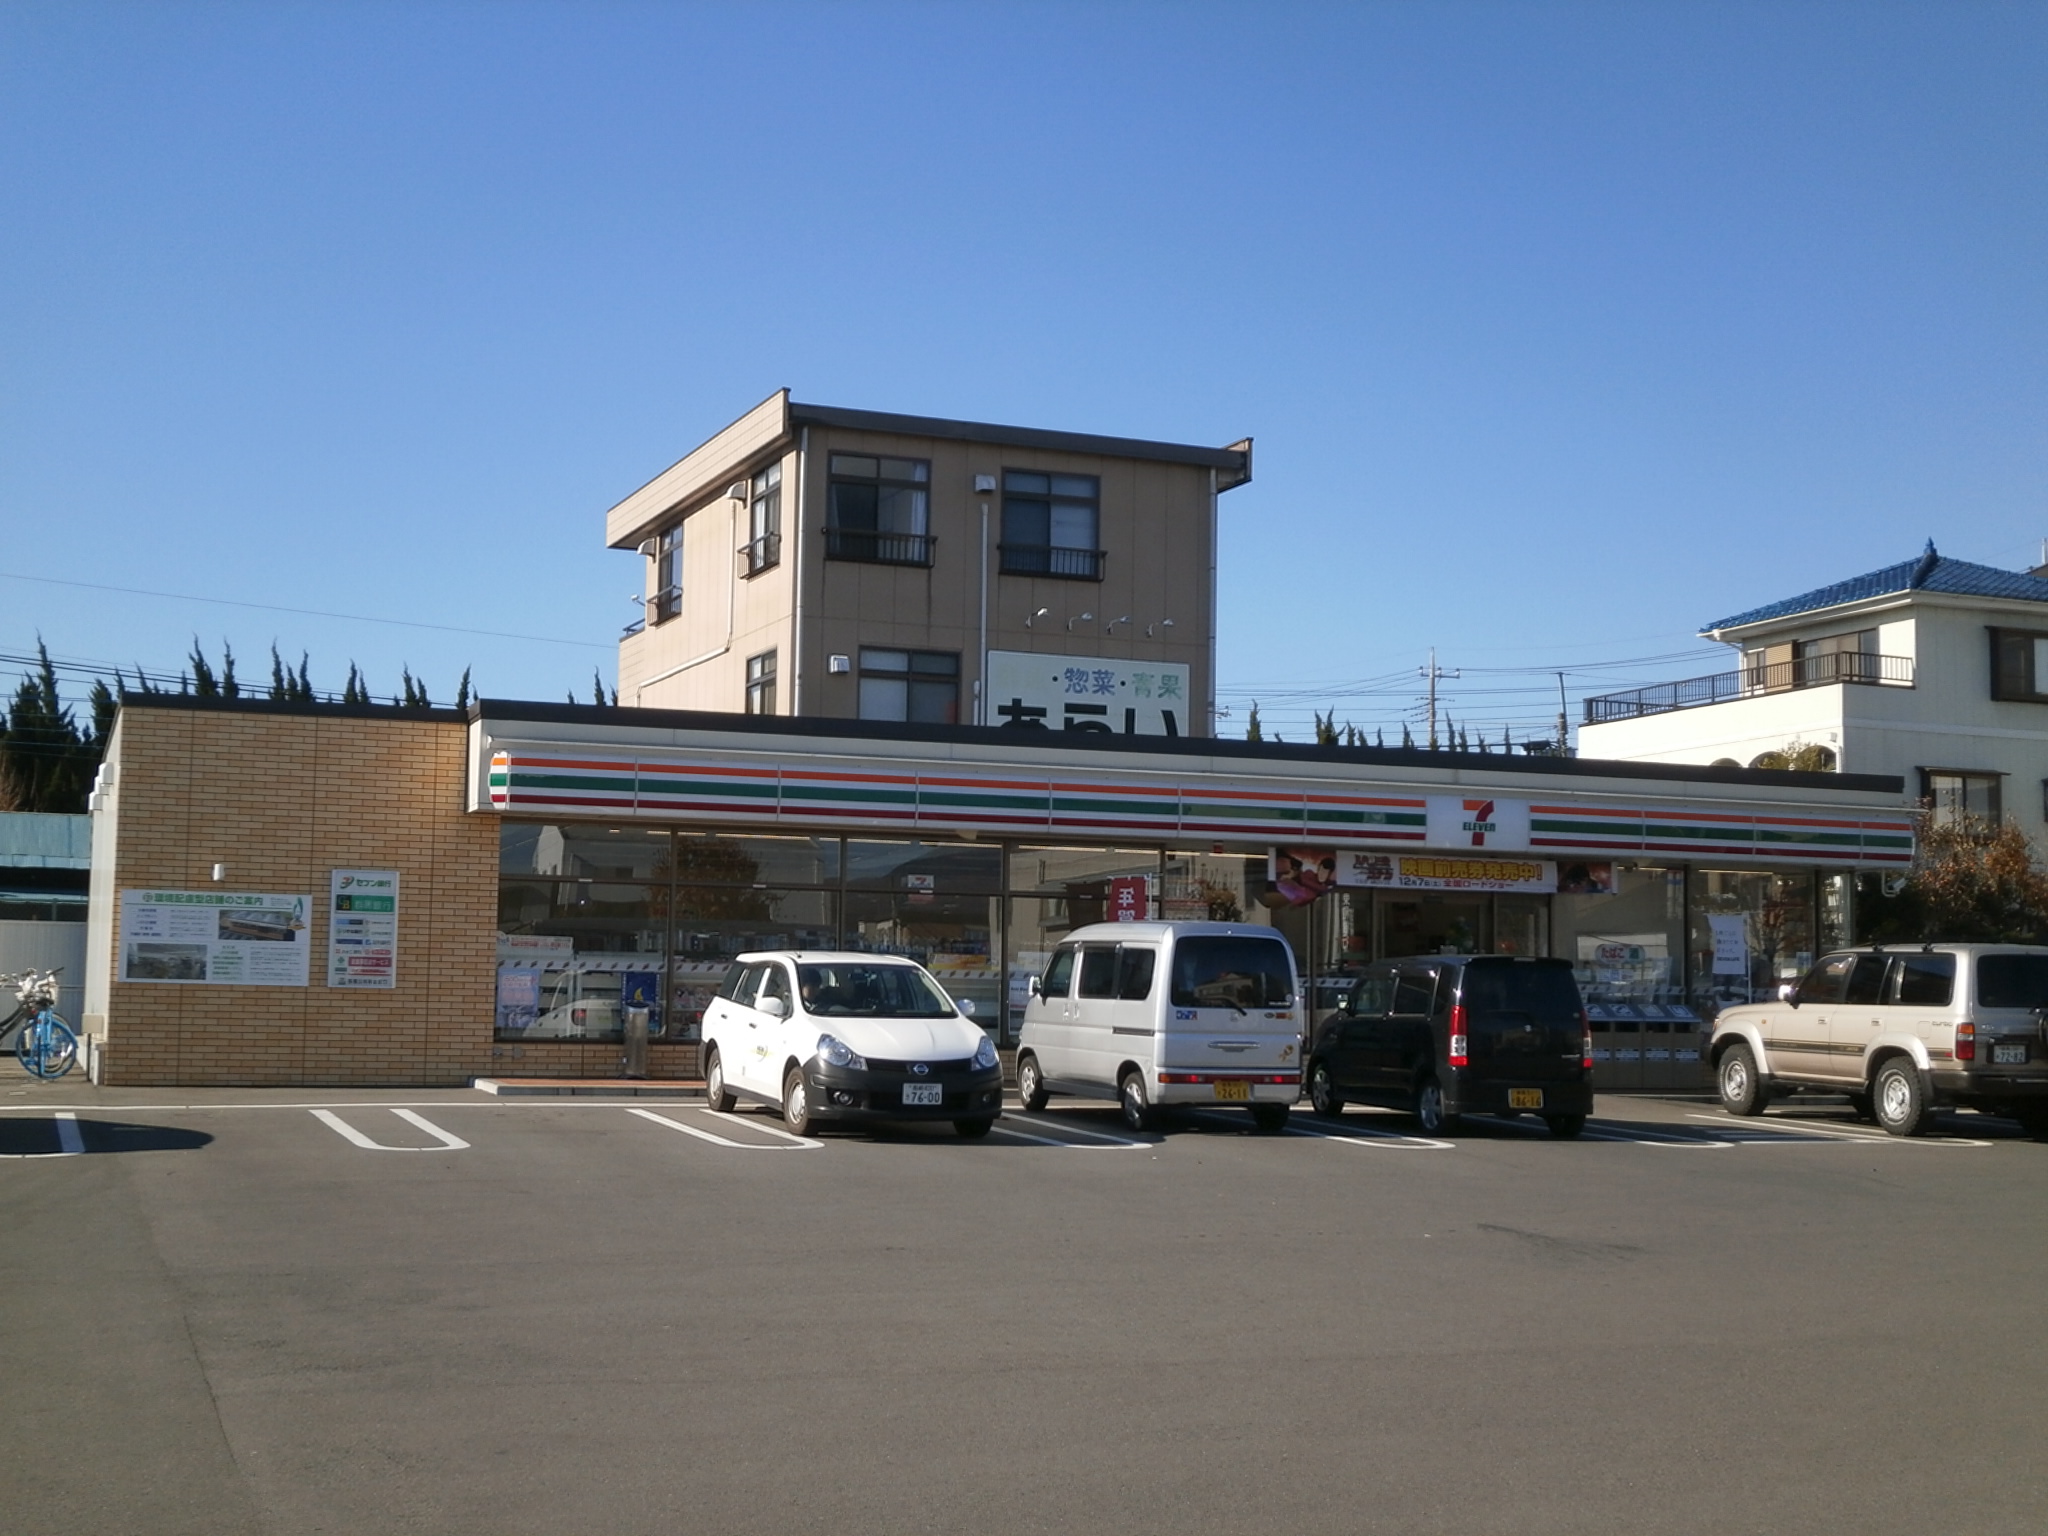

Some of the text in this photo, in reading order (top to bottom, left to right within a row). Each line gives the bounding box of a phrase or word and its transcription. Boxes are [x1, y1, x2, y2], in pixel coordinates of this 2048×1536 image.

[1463, 799, 1495, 846] 7
[356, 878, 392, 888] セブン銀行
[1601, 947, 1625, 959] たばこ
[911, 1092, 940, 1103] 76-00
